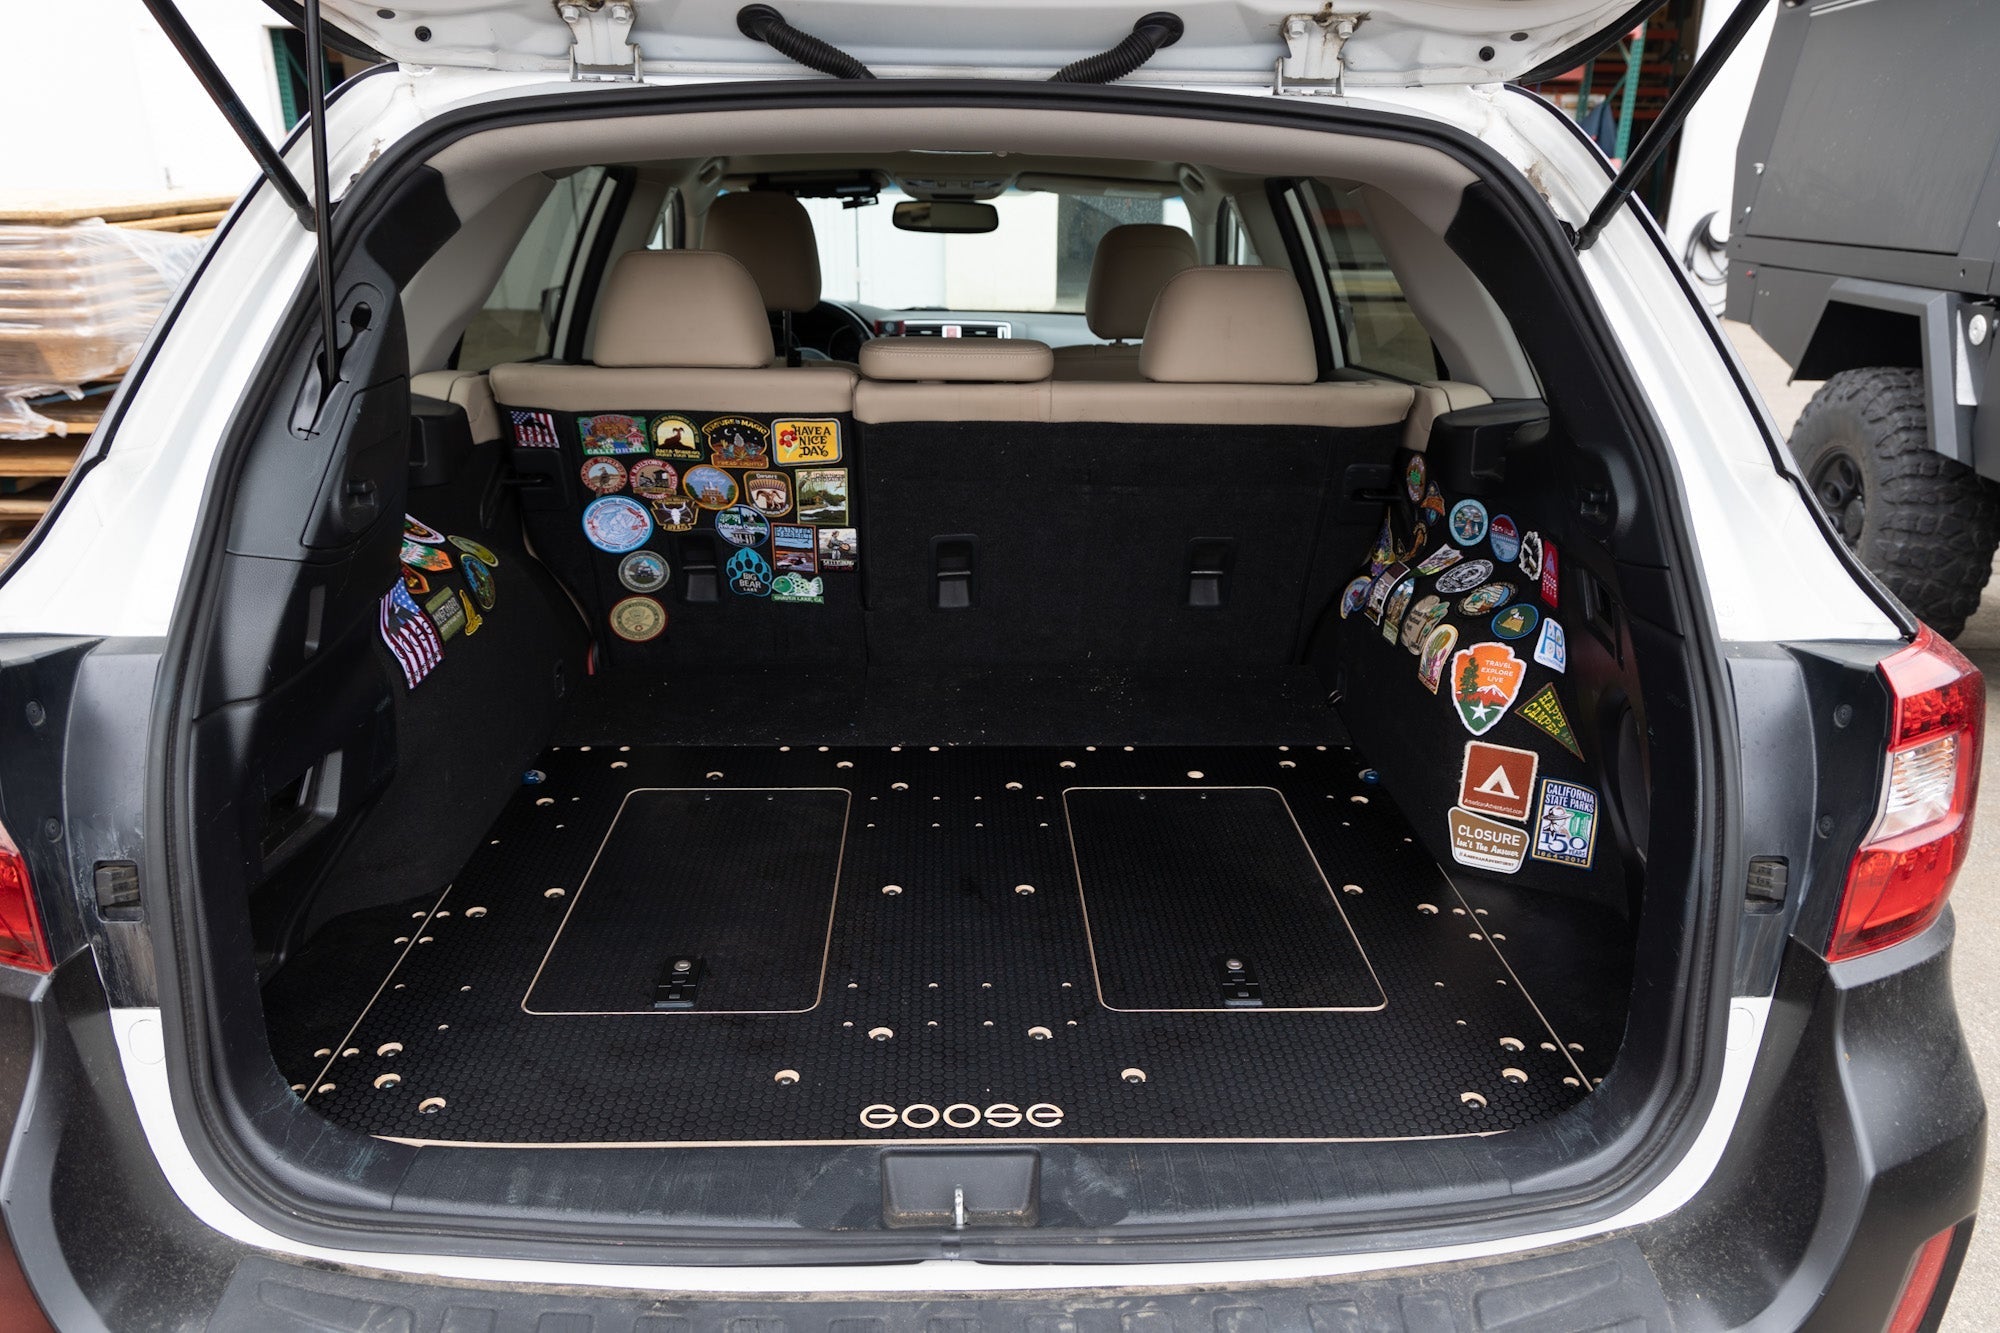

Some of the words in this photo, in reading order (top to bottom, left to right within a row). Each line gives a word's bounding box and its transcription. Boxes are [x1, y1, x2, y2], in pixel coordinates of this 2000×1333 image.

[706, 418, 735, 433] NATURE
[741, 420, 767, 433] MAGIC
[791, 424, 822, 436] HAVE
[823, 426, 831, 436] A
[799, 436, 828, 446] NICE
[587, 446, 647, 455] CALIFORNIA
[798, 446, 829, 458] DAY
[632, 459, 662, 474] RAILTOWN
[743, 572, 757, 581] BIG
[739, 580, 761, 588] BEAR
[1485, 660, 1512, 669] TRAVEL
[1481, 667, 1514, 677] EXPLORE
[1487, 676, 1504, 684] LIVE
[1539, 691, 1566, 729] HAPPY
[1524, 702, 1560, 736] CAMPER
[1547, 783, 1594, 804] CALIFORNIA
[1545, 794, 1568, 807] STATE
[1570, 799, 1594, 813] PARKS
[1458, 824, 1521, 847] CLOSURE
[1457, 838, 1473, 849] Isn't
[1475, 841, 1489, 853] The
[1490, 845, 1520, 858] Answer
[1541, 832, 1588, 853] 150
[1568, 849, 1587, 858] YEARS
